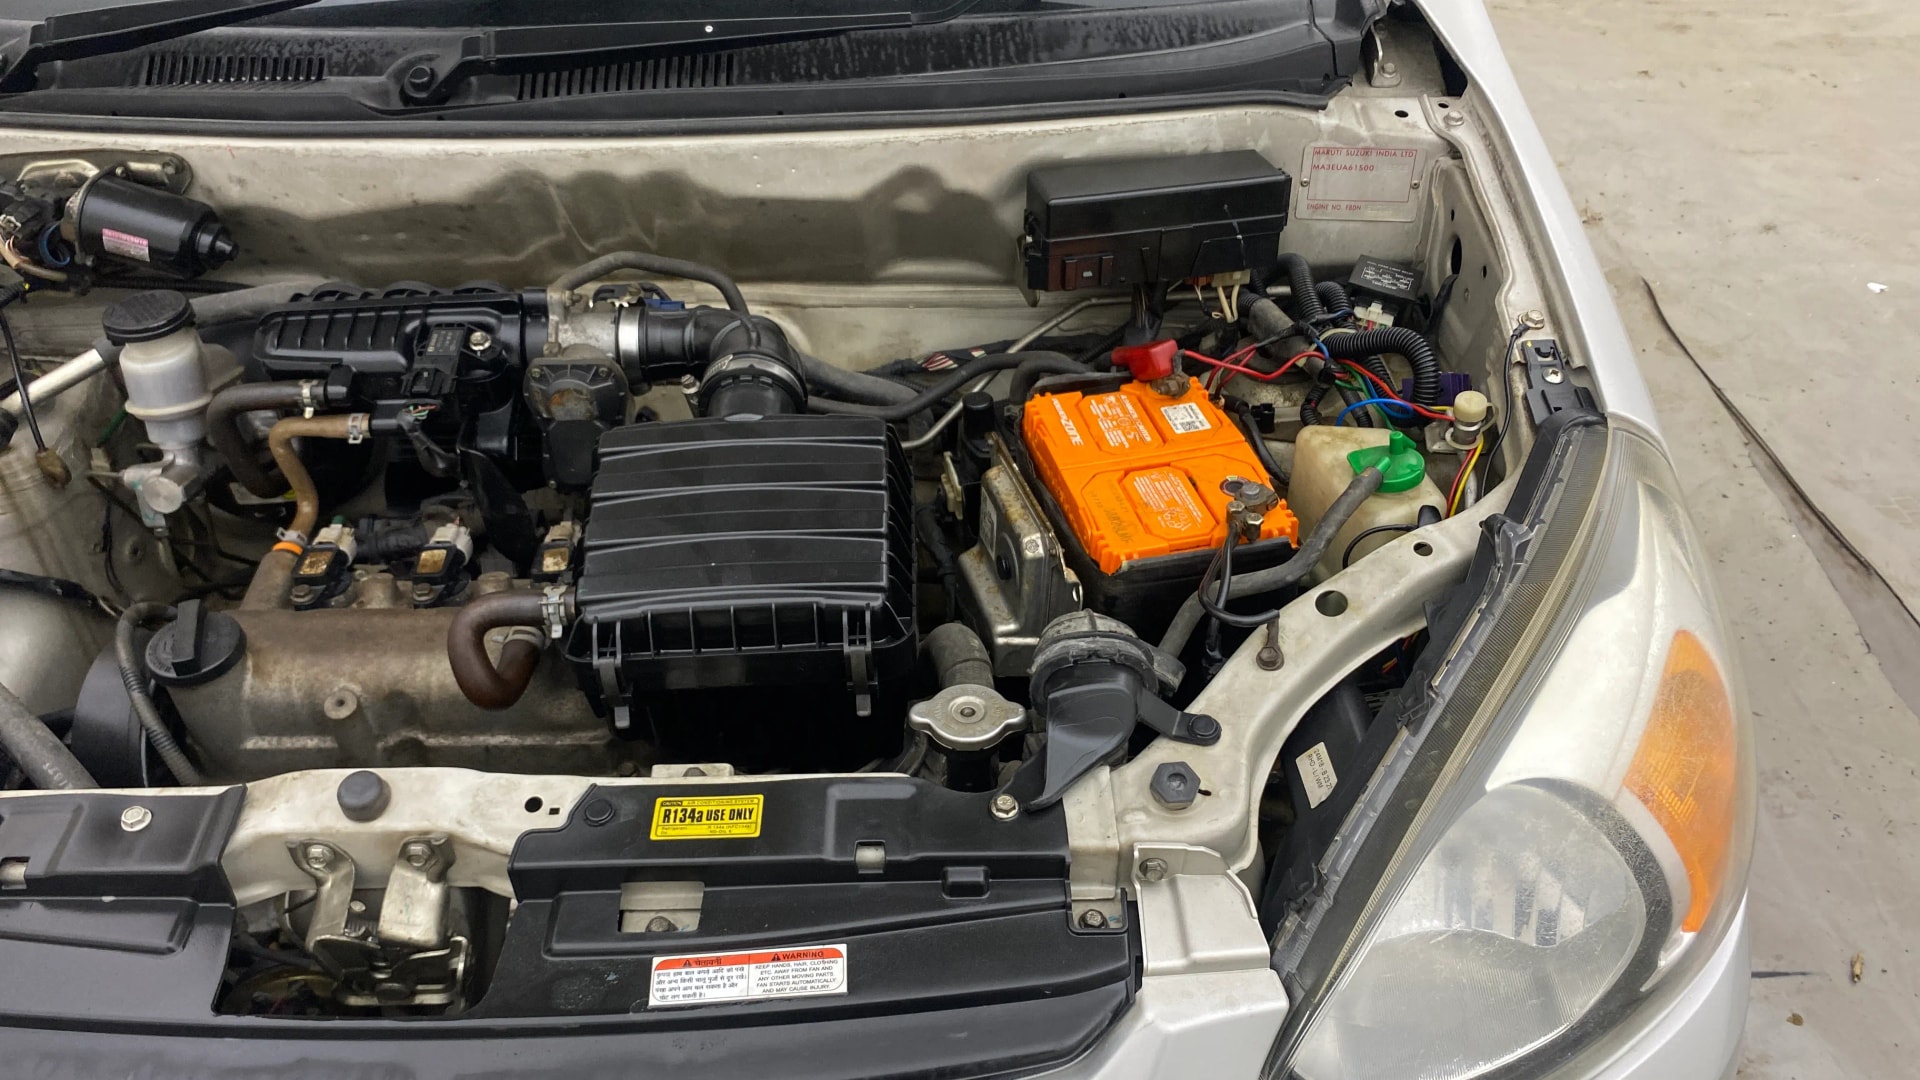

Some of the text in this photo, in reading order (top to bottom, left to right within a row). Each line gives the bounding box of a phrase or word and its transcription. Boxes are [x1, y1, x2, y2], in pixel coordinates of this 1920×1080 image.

[1313, 149, 1342, 157] MARUTI
[1346, 149, 1373, 157] SUZUKI
[1375, 150, 1397, 158] INDIA
[662, 807, 755, 824] R134a USE ONLY
[782, 951, 824, 960] WARNING
